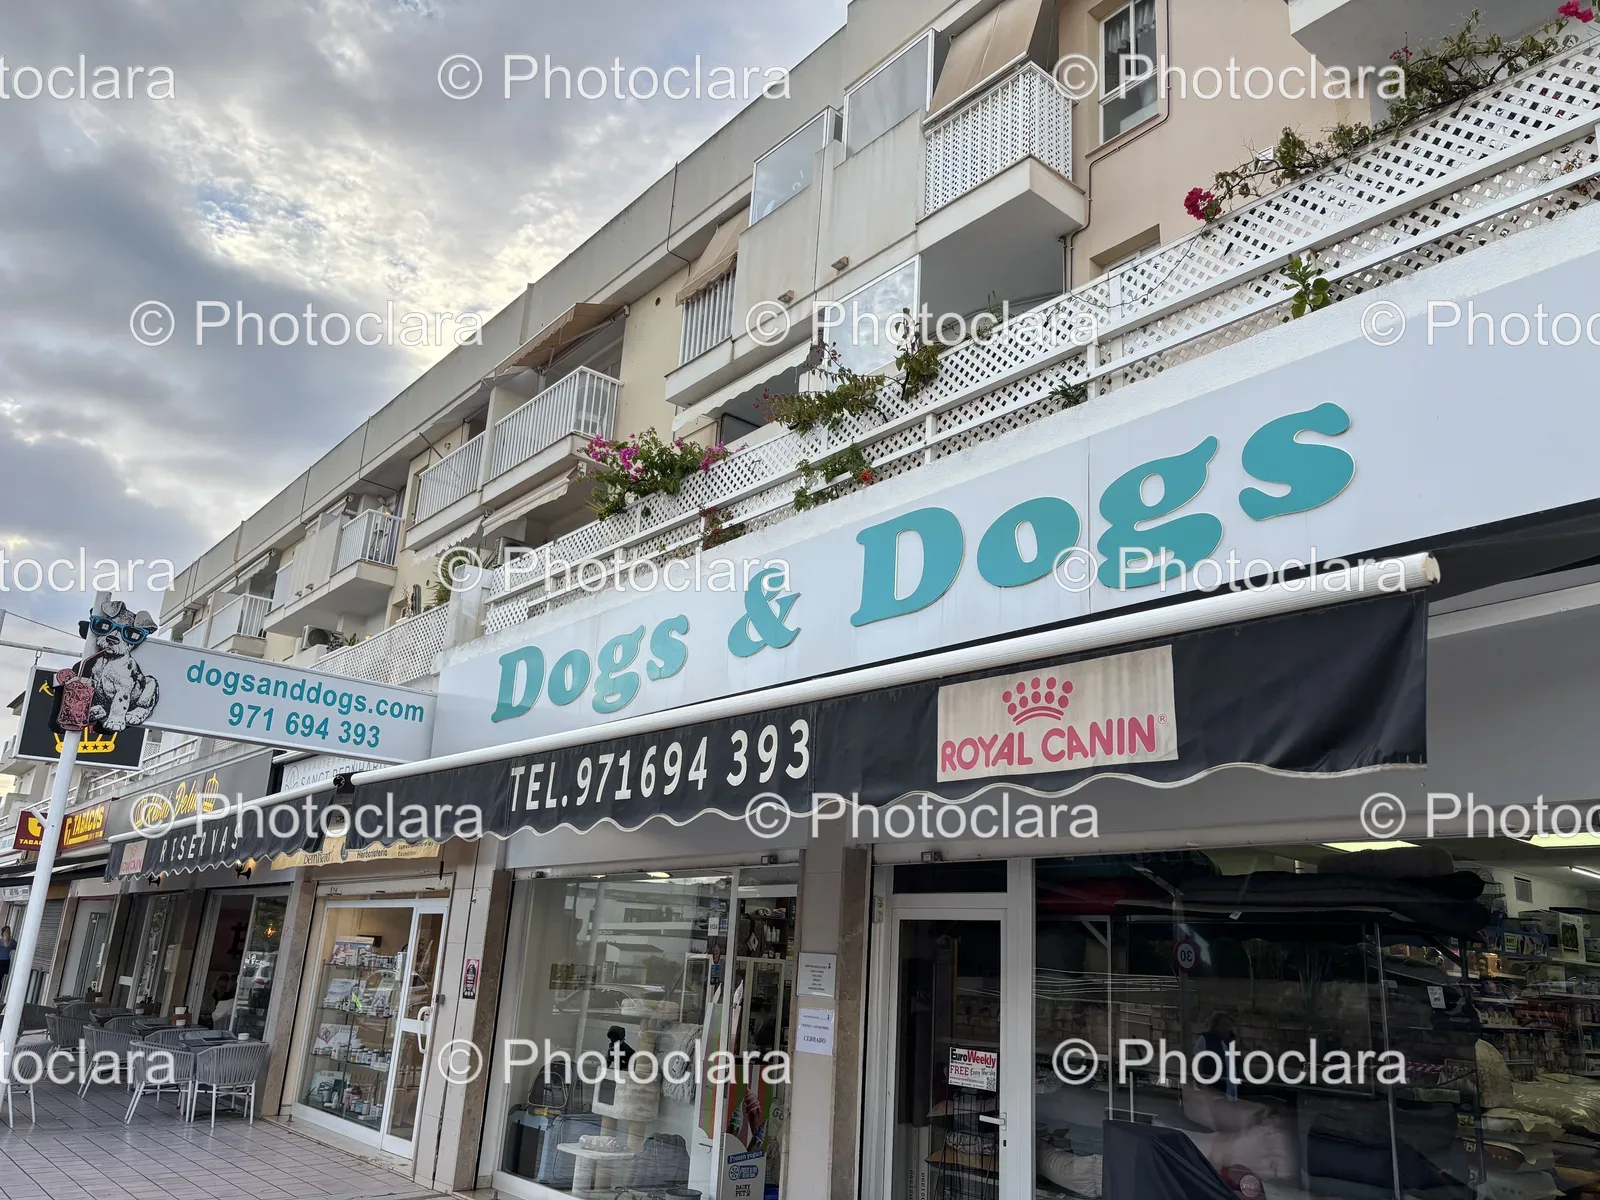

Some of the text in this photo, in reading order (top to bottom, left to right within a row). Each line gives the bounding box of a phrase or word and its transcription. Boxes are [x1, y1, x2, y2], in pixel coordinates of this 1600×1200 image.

[490, 402, 1355, 723] Dogs & Dogs
[186, 660, 425, 723] dogsanddogs.com
[228, 702, 381, 749] 971 694 393
[941, 731, 1033, 773] ROYAL
[1041, 713, 1156, 763] CANIN
[726, 718, 810, 787] 393
[803, 1035, 827, 1044] CERRADO
[950, 1048, 996, 1069] EuroWeekly
[950, 1064, 969, 1077] FREE
[747, 1151, 763, 1160] yogurt
